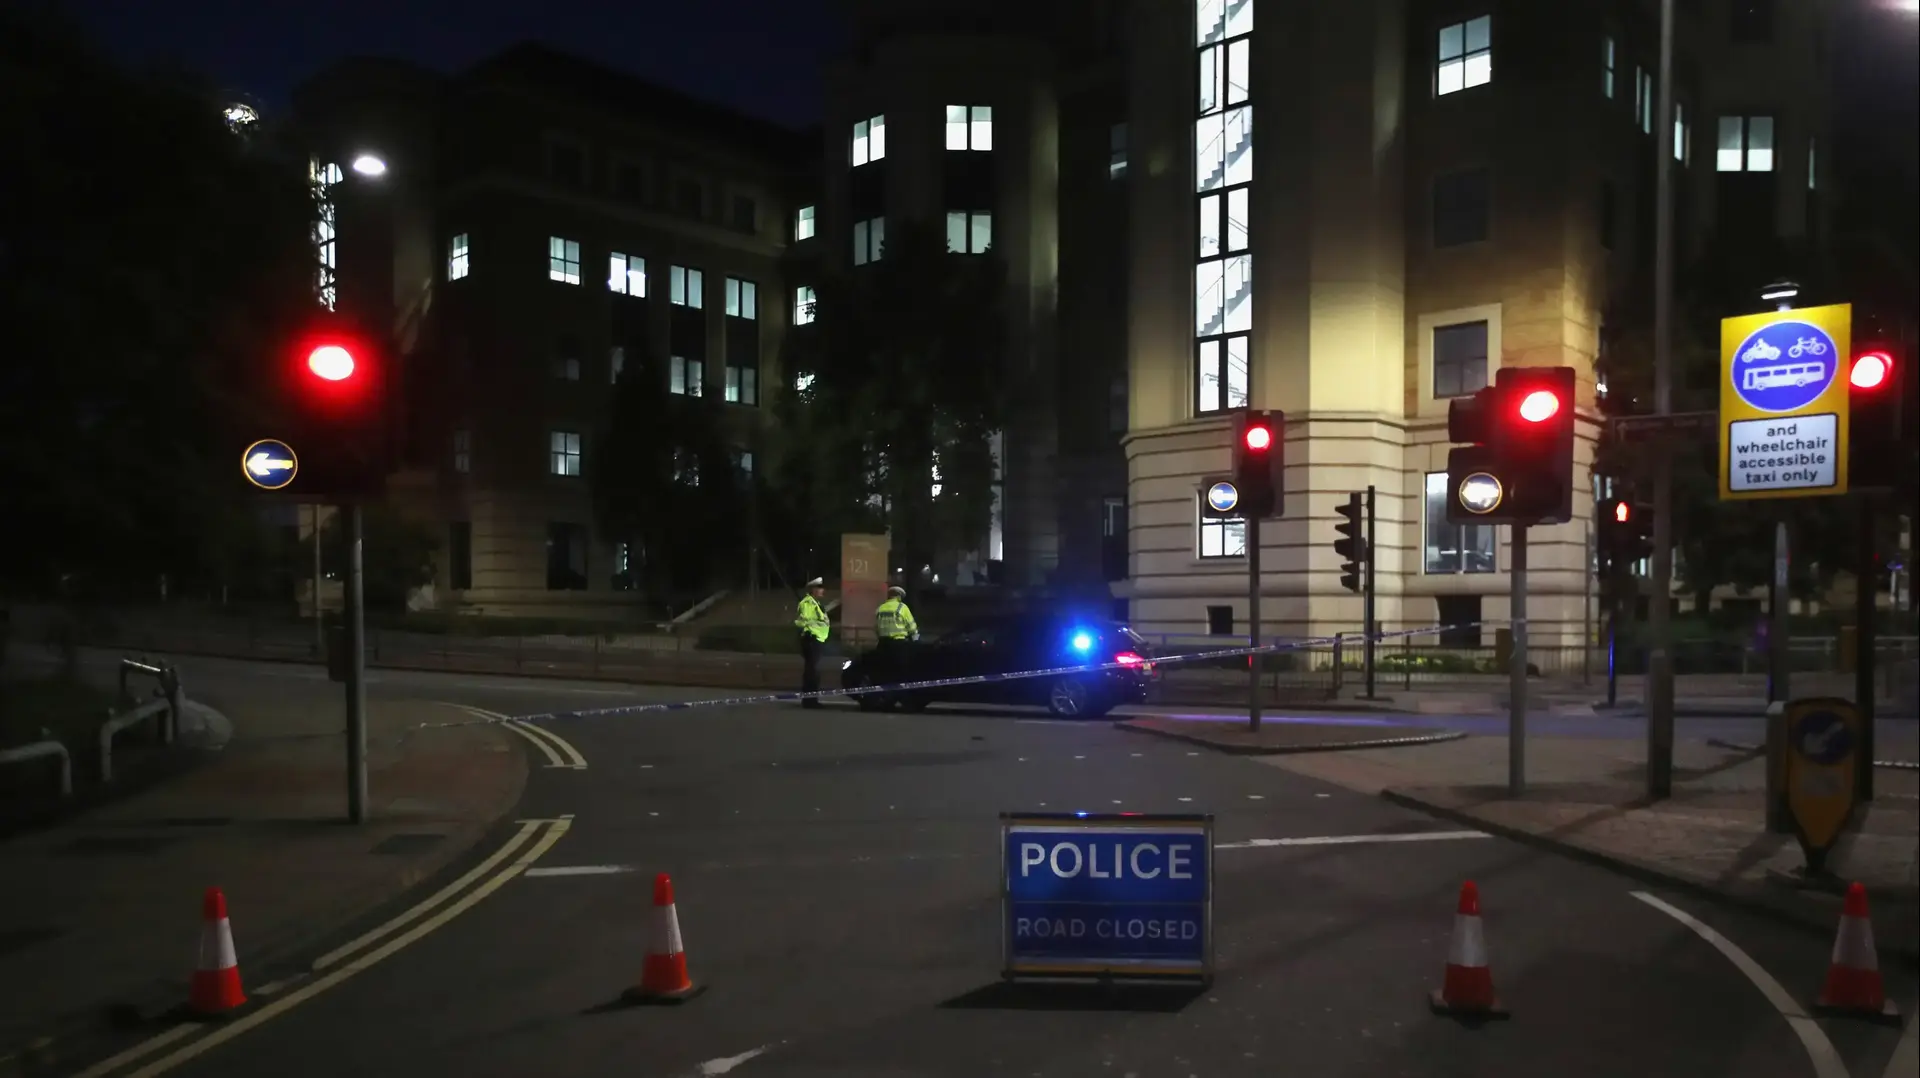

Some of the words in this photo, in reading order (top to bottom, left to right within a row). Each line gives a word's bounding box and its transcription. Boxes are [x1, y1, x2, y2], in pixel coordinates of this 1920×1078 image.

[1766, 423, 1797, 437] and
[1737, 437, 1828, 454] wheelchair
[1739, 452, 1826, 469] accessible
[1746, 469, 1776, 484] taxi
[1782, 468, 1818, 483] only
[849, 558, 868, 573] 121
[1020, 842, 1193, 879] POLICE
[1017, 917, 1086, 938] ROAD
[1096, 919, 1198, 940] CLOSED
